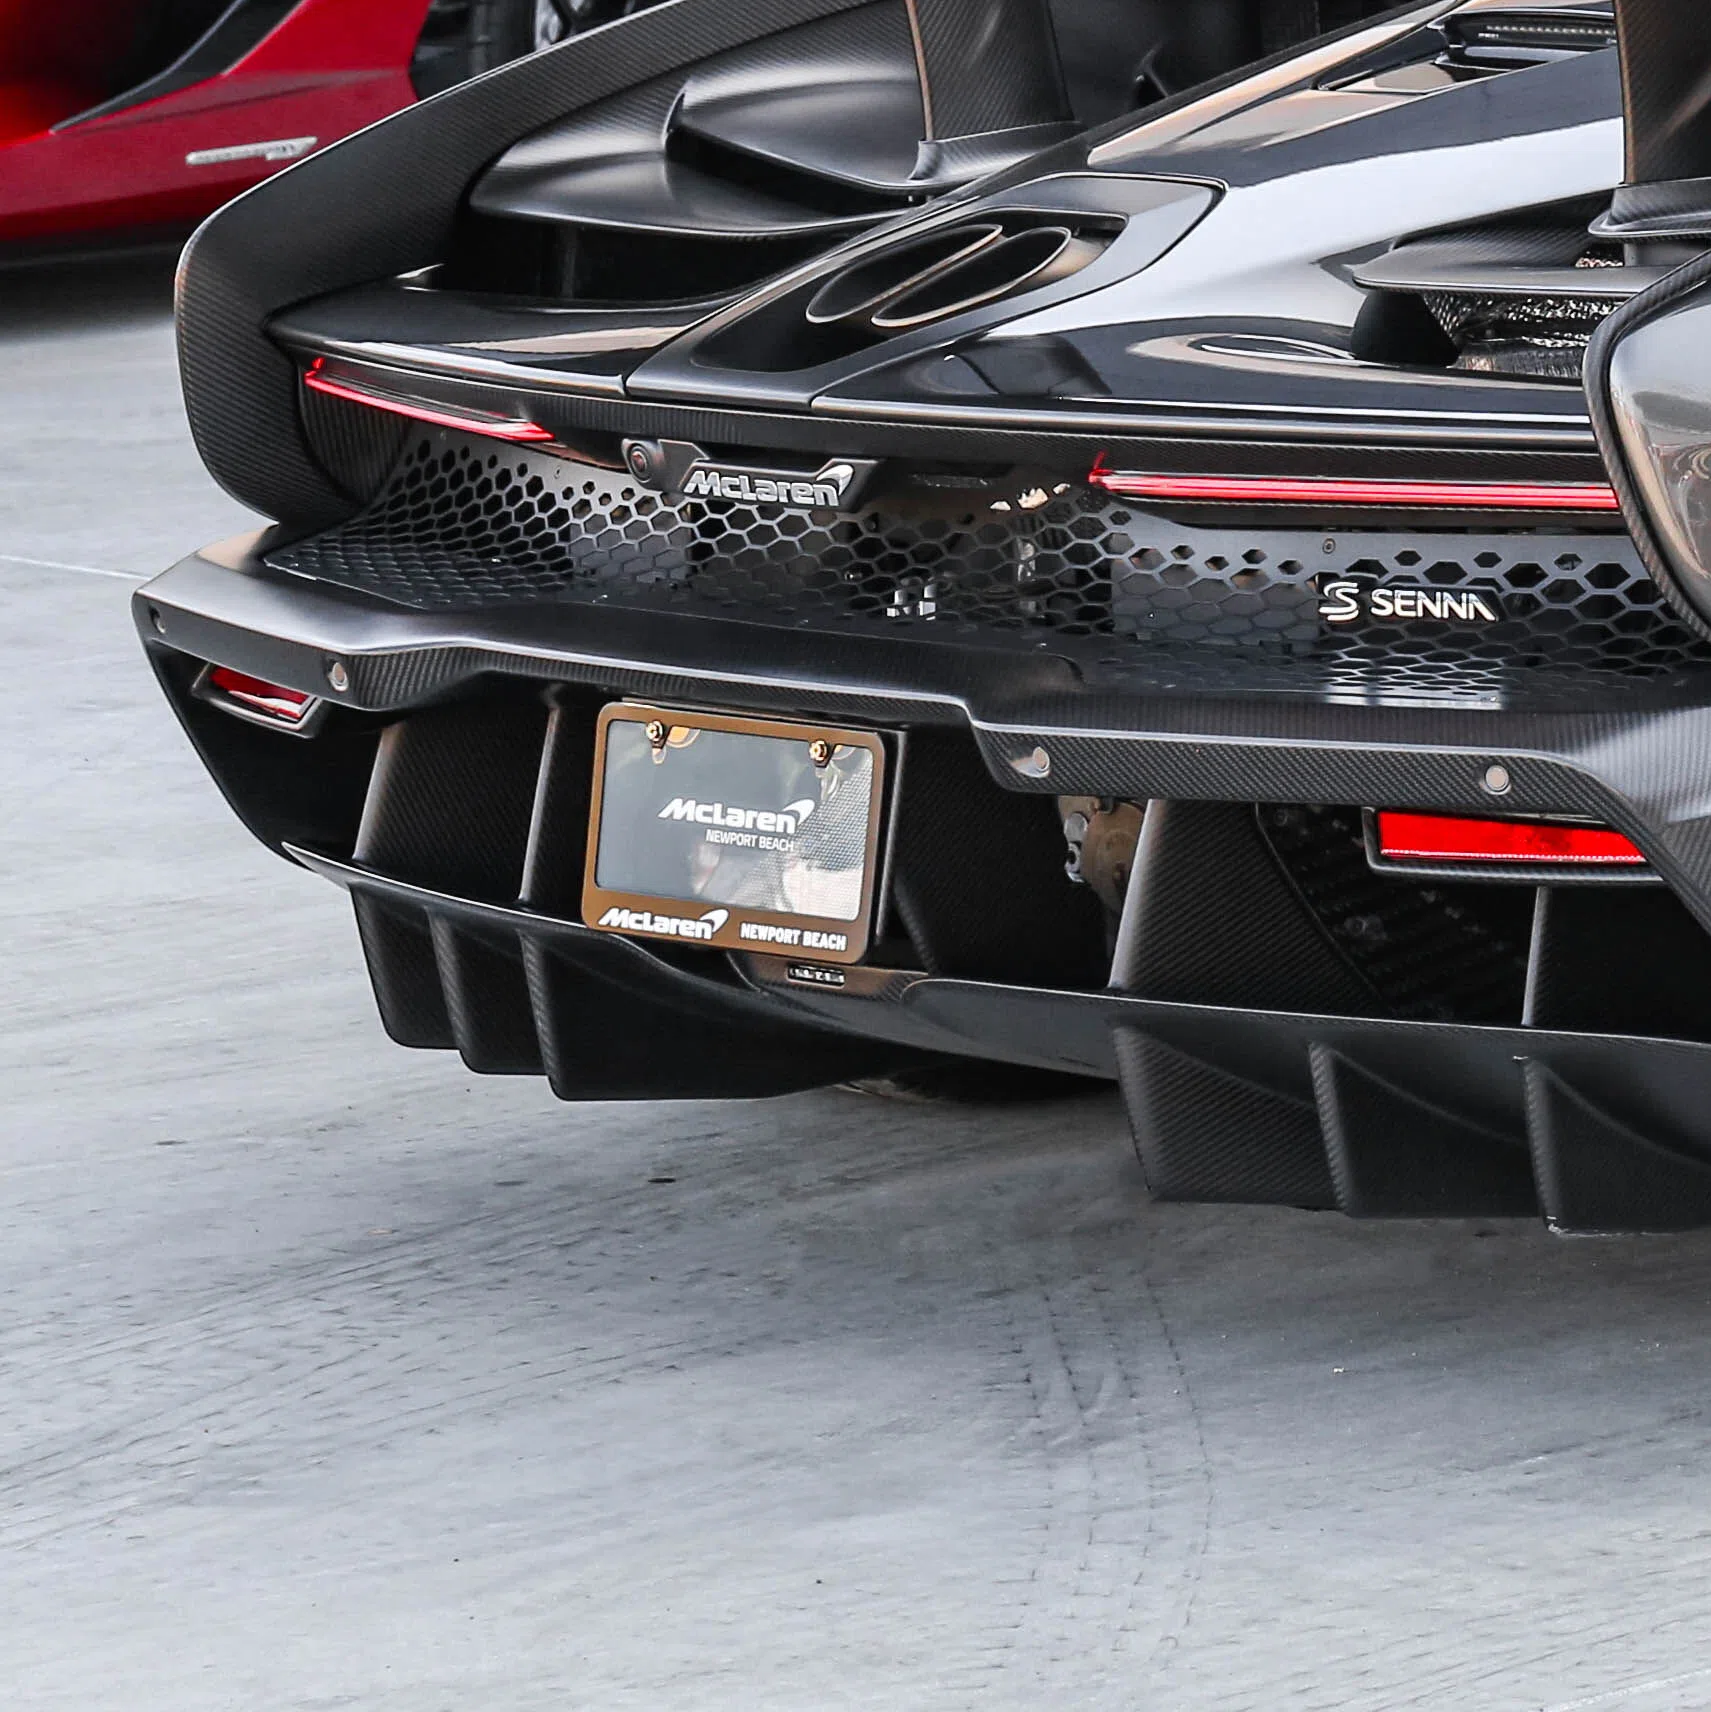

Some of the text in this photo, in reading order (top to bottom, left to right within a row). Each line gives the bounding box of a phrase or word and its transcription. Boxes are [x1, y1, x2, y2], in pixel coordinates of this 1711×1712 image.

[683, 470, 839, 507] McLaren
[1371, 588, 1497, 621] SENNA
[657, 798, 796, 834] McLaren
[705, 828, 794, 852] NEWPORT BEACH
[598, 907, 848, 952] McLaren NEWPORT BEACH
